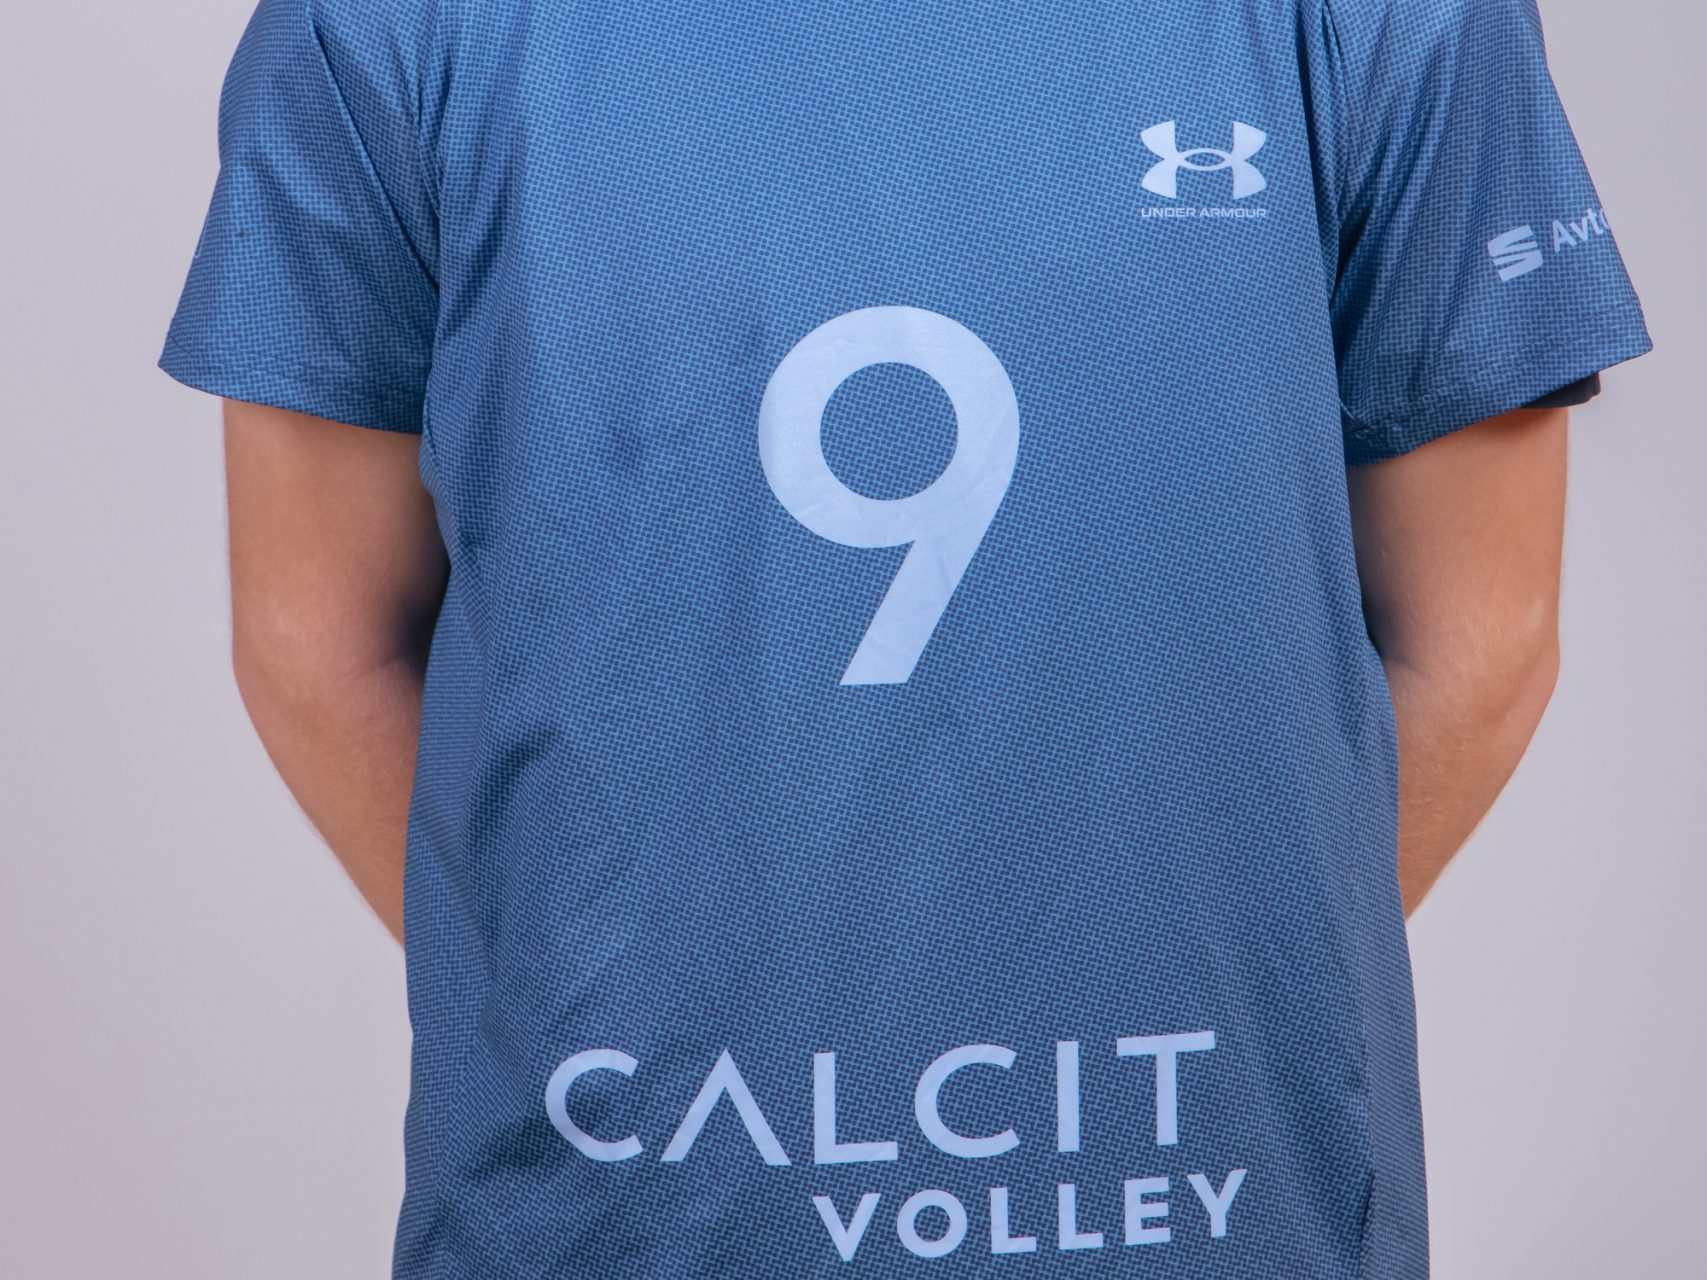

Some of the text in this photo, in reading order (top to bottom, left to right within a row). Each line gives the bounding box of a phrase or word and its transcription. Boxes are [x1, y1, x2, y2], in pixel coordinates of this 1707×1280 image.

[1141, 207, 1266, 218] UNDER ARMOUR
[758, 305, 1020, 686] 9
[812, 1168, 1248, 1262] VOLLEY
